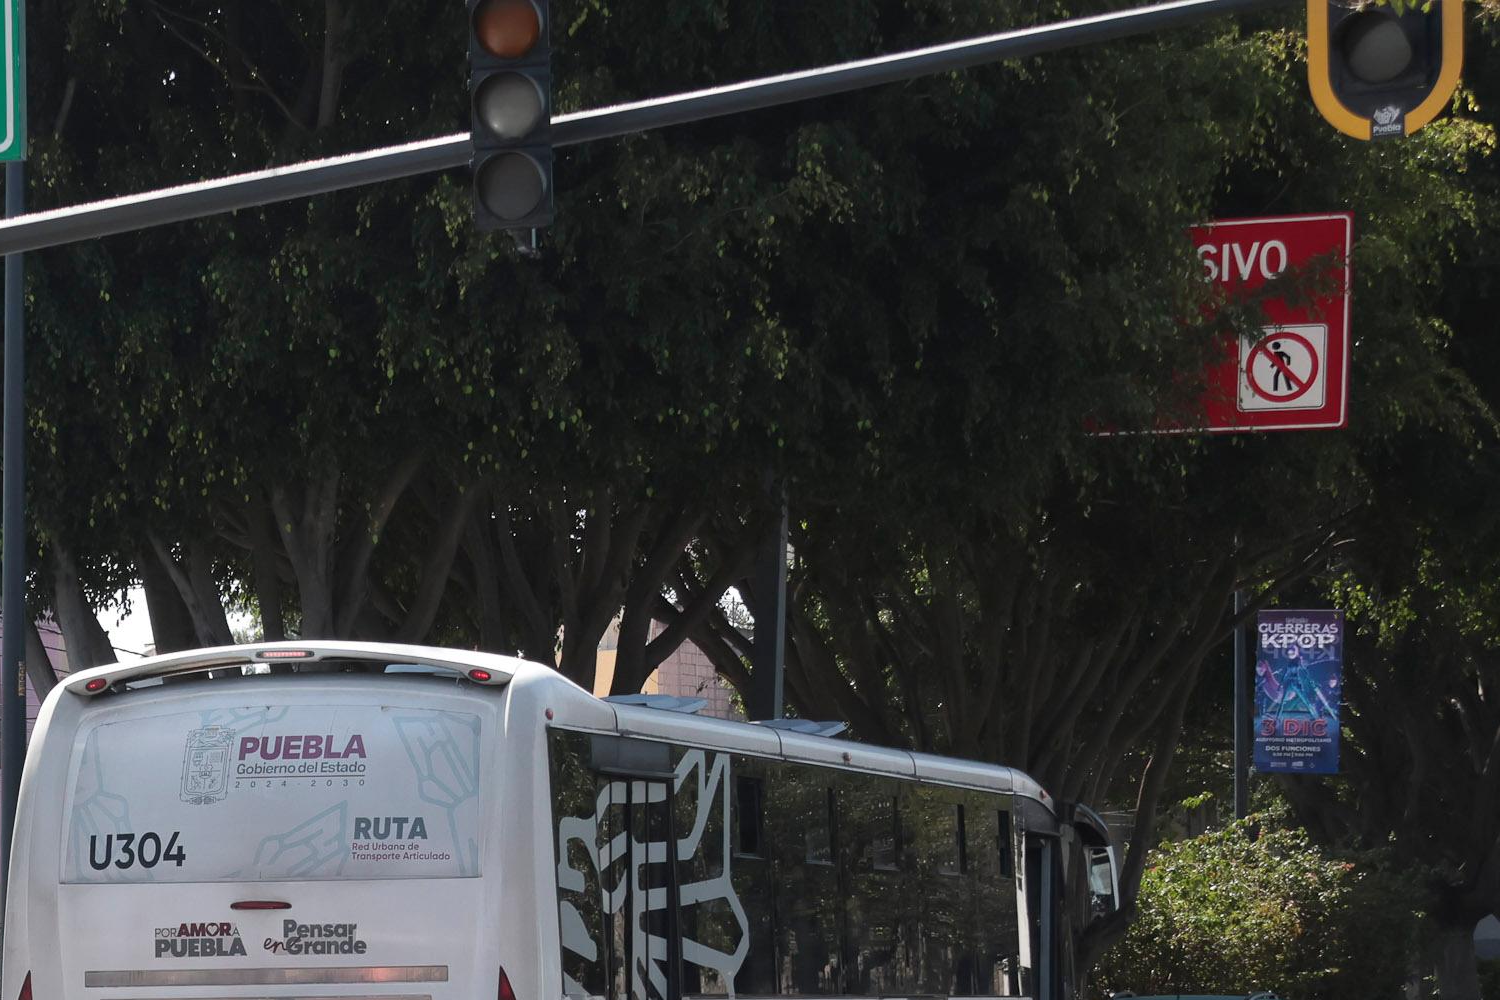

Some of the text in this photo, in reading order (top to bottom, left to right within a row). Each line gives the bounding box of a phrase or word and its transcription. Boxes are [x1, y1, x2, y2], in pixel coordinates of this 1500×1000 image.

[1258, 623, 1339, 634] GUERRERAS
[1261, 634, 1336, 649] KPOP
[1261, 719, 1327, 736] 3 DIC
[238, 735, 367, 760] PUEBLA
[236, 761, 366, 775] Gobierno del Estado
[353, 817, 428, 840] RUTA
[89, 831, 186, 871] U304
[352, 842, 420, 851] Red Urbana de
[351, 851, 451, 861] Transporte Articulado
[283, 919, 358, 938] Pensar
[154, 937, 248, 958] PUEBLA
[286, 937, 367, 956] Grande
